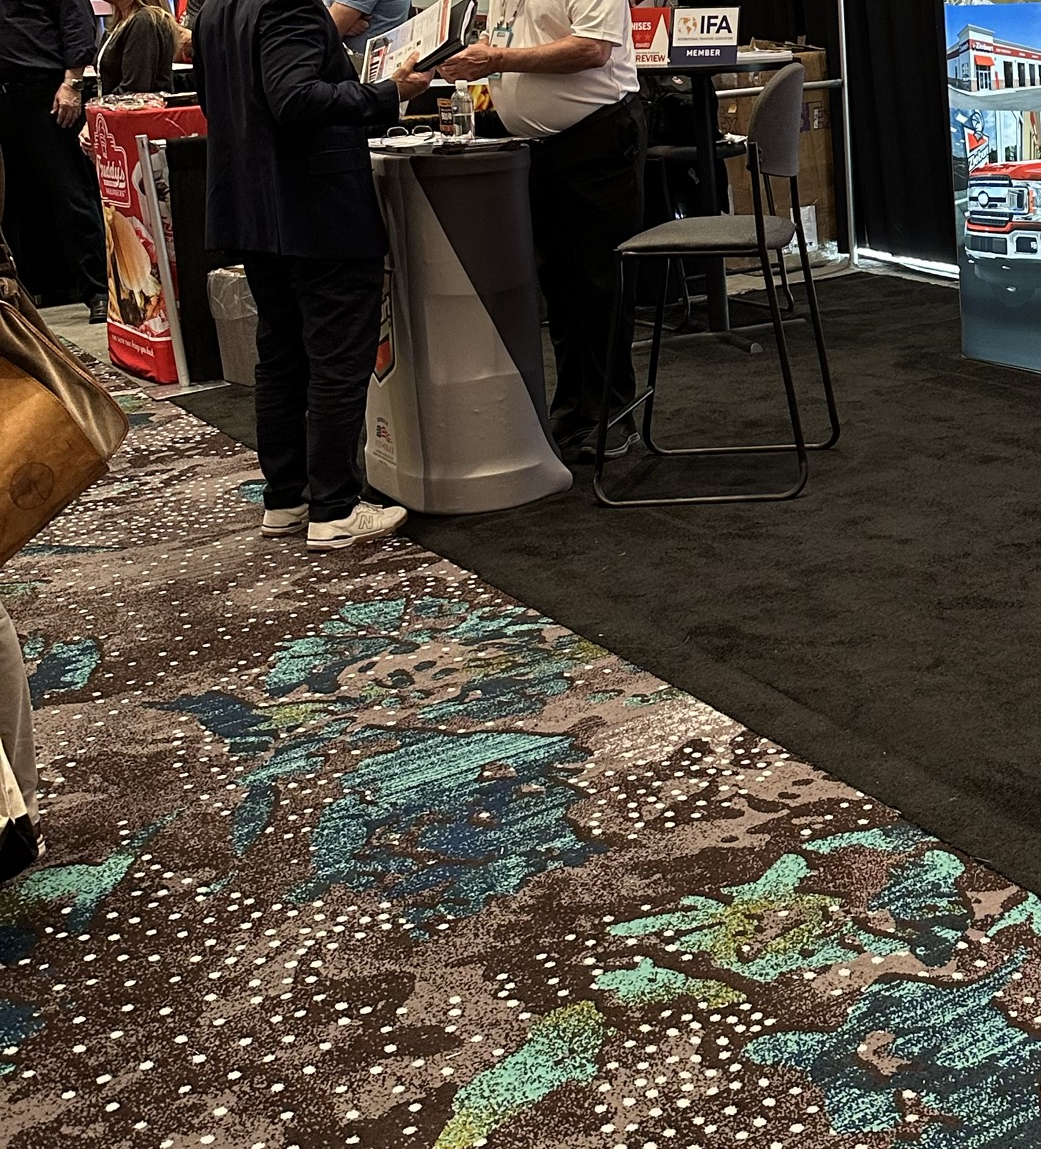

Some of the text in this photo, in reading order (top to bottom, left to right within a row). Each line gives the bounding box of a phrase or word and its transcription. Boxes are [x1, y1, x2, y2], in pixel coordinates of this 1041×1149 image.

[700, 15, 732, 34] IFA
[686, 48, 721, 57] MEMBER
[635, 54, 666, 63] REVIEW
